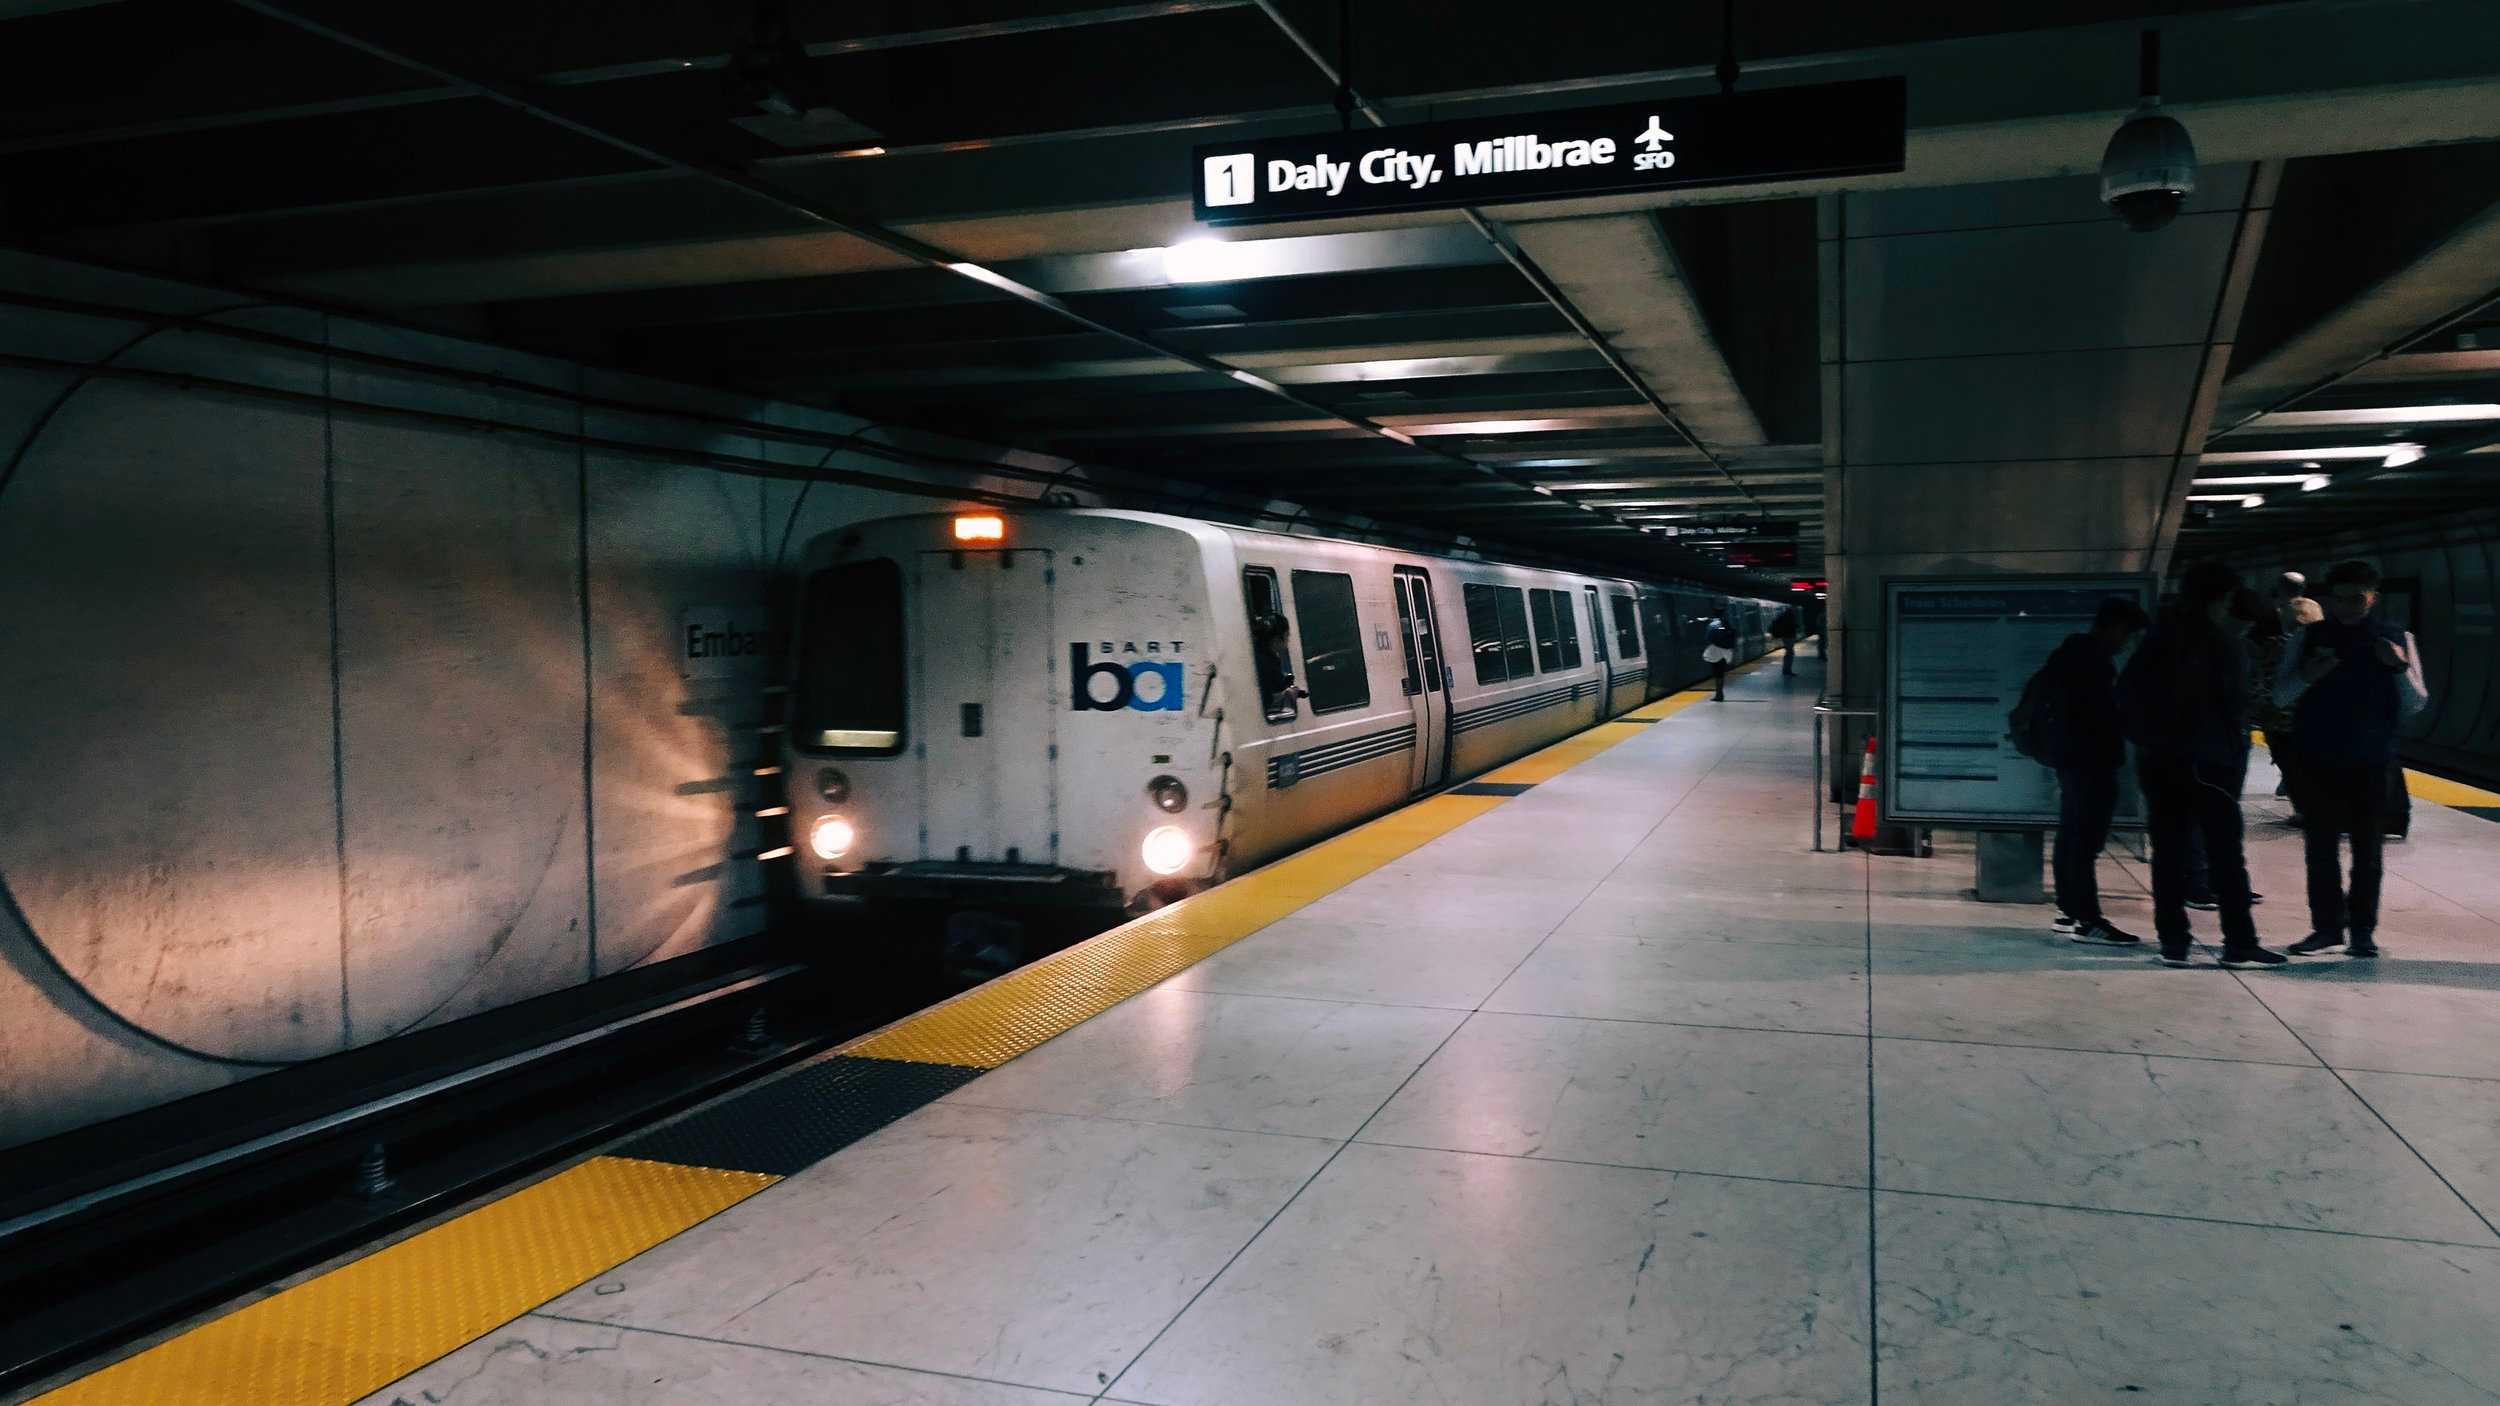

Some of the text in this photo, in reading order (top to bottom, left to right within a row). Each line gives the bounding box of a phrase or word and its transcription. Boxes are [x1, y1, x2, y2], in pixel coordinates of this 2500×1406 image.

[1222, 134, 1617, 198] 1 Daly City, Millbrae
[1633, 151, 1676, 171] SFO
[687, 620, 758, 658] Emba
